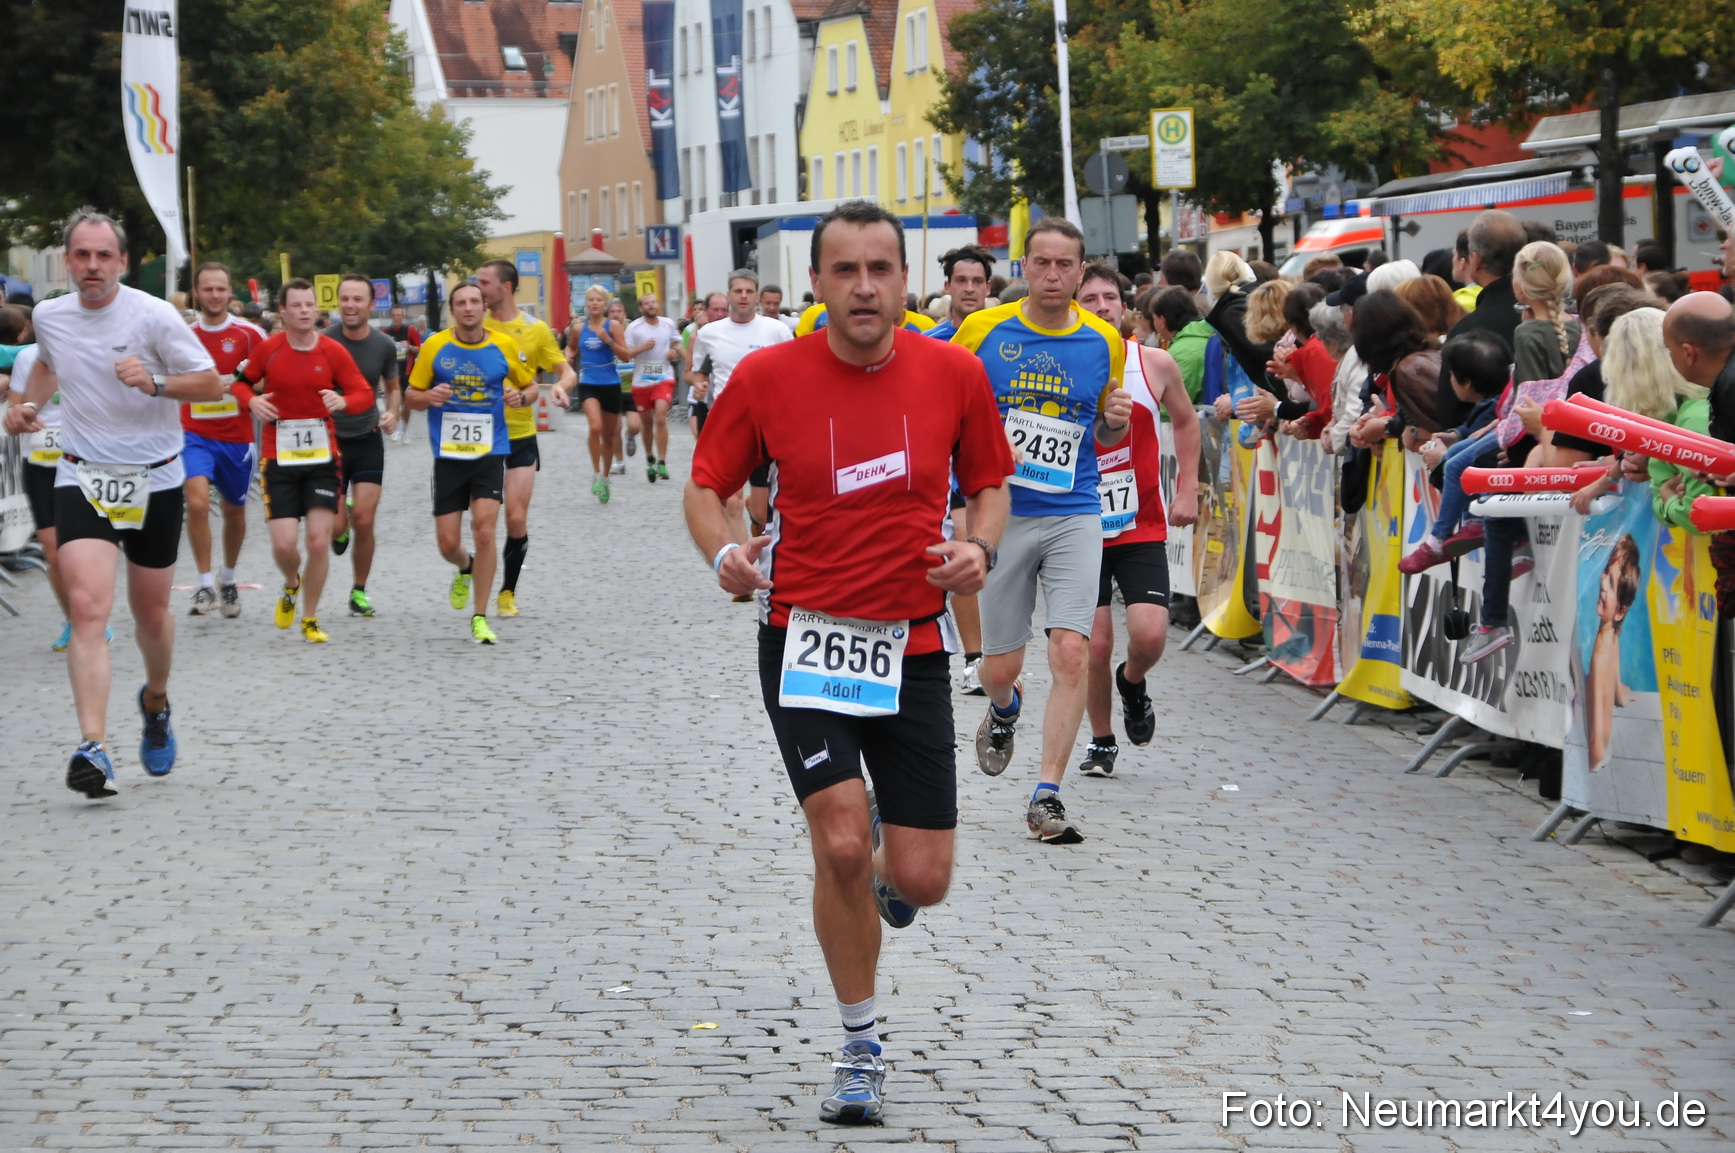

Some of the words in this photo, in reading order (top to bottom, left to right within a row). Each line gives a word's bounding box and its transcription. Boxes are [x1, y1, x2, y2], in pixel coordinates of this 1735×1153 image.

[839, 119, 860, 144] HOTEL
[322, 286, 334, 302] D
[452, 424, 482, 441] 215
[1008, 416, 1035, 429] PARTL
[1035, 423, 1071, 437] Neumarkt
[292, 430, 313, 447] 14
[1639, 437, 1674, 455] BKK
[1012, 429, 1072, 467] 2433
[1676, 447, 1718, 467] Audi
[1101, 455, 1119, 467] DEHN
[77, 466, 102, 475] PARTL
[856, 463, 887, 482] DEHN
[1022, 465, 1050, 481] Horst
[1524, 474, 1547, 485] BKK
[1550, 474, 1578, 485] Audi
[91, 479, 136, 504] 302
[1099, 478, 1124, 487] umarkt
[1100, 486, 1131, 512] 17
[796, 629, 893, 678] 2656
[821, 681, 862, 699] Adolf
[1515, 671, 1551, 700] 92318
